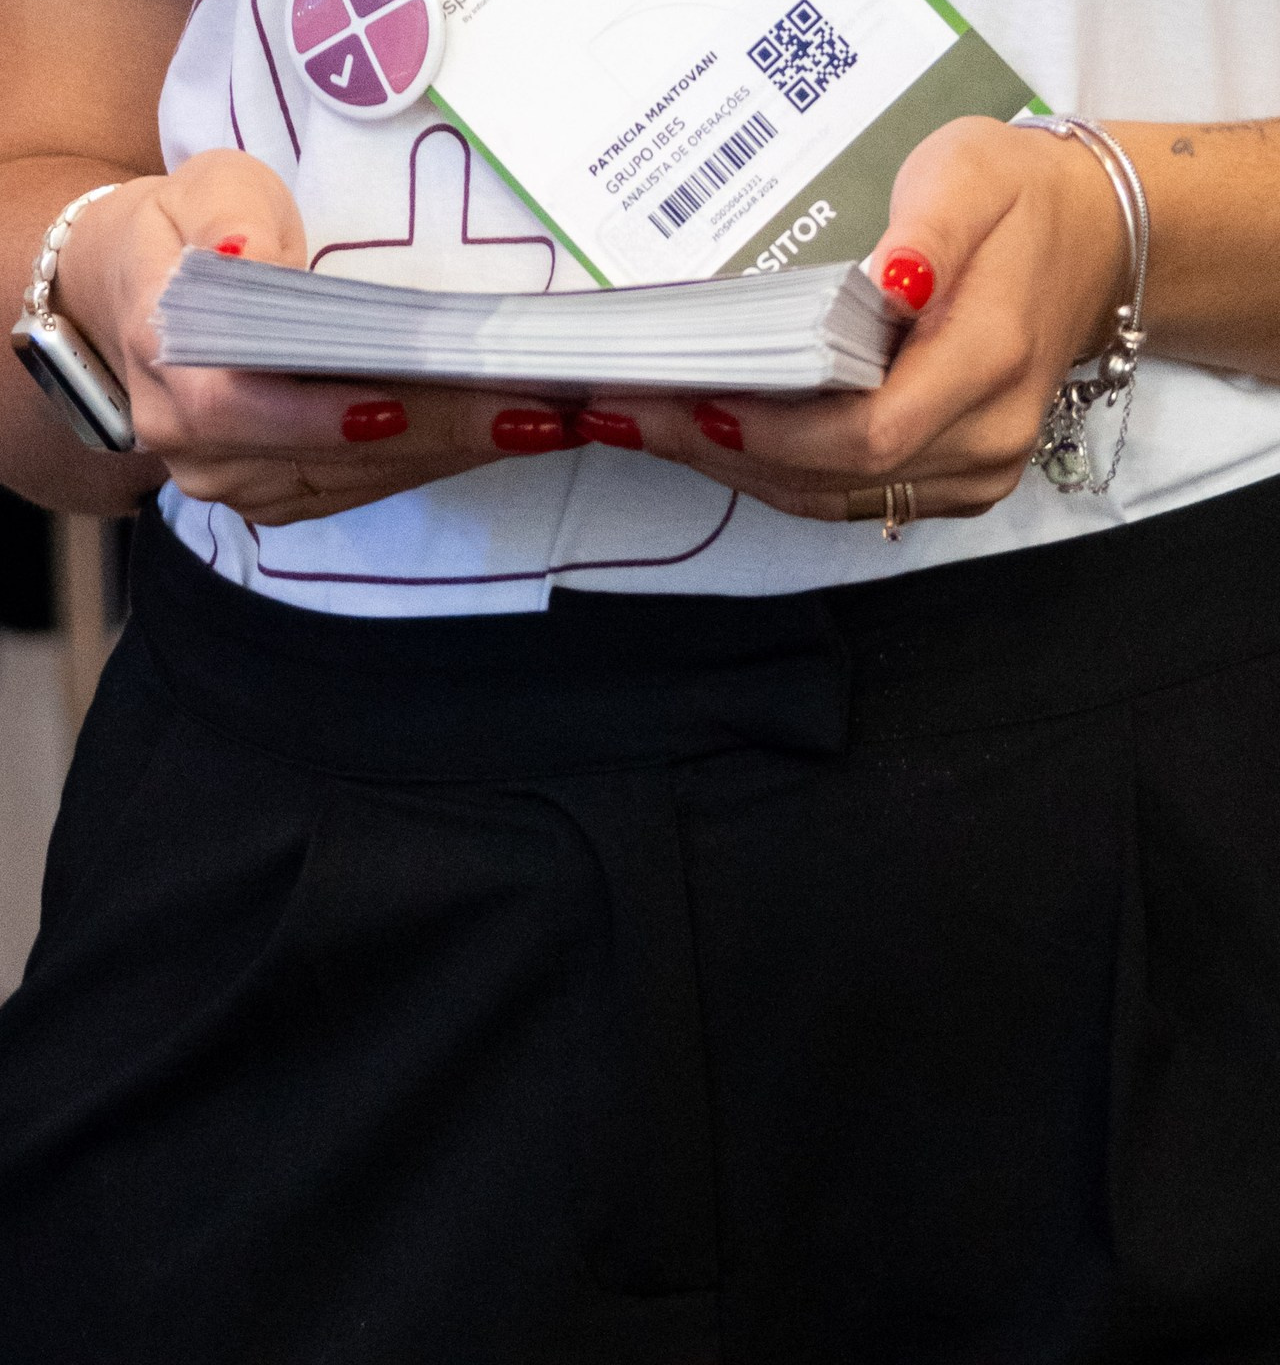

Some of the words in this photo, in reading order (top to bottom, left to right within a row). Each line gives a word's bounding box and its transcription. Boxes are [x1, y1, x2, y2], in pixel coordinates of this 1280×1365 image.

[589, 121, 646, 177] PATRÍCIA
[644, 51, 718, 124] MANTOVANI
[622, 161, 672, 212] ANALISTA
[672, 145, 689, 164] DE
[687, 85, 751, 146] OPERAÇÕES
[605, 147, 654, 195] GRUPO
[652, 116, 686, 153] IBES
[760, 176, 780, 199] 2025
[742, 199, 838, 276] SITOR
